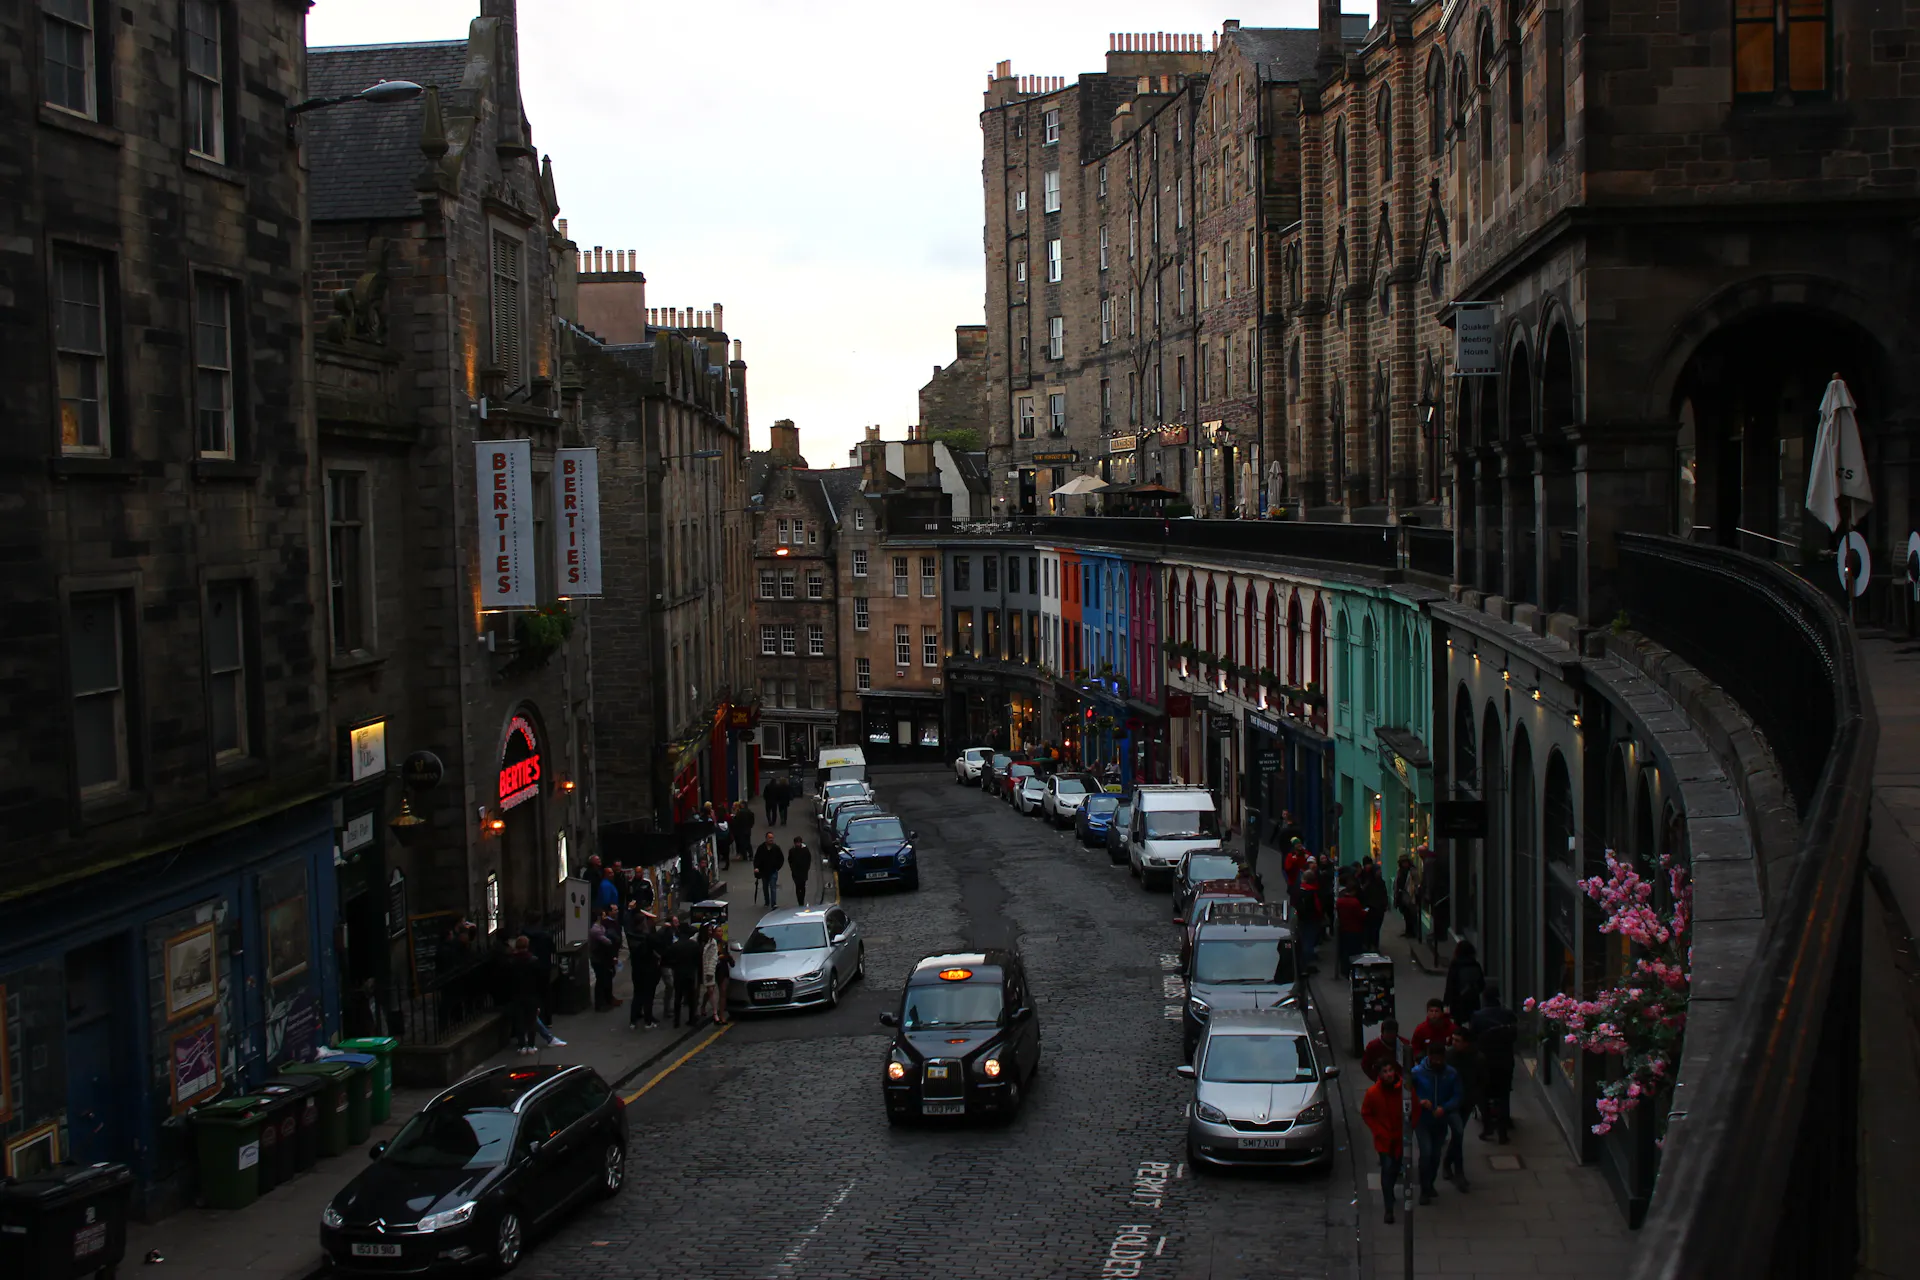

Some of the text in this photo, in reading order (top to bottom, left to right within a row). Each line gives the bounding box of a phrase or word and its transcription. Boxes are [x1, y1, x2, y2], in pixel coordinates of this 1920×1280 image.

[1461, 323, 1490, 331] Quaker
[1461, 336, 1492, 344] Meeting
[1463, 348, 1489, 356] House
[492, 453, 511, 593] BERTIES
[563, 459, 580, 583] BERTIES
[500, 754, 541, 799] BERTIE'S
[1243, 1138, 1280, 1146] SM17 XUV
[1128, 1161, 1171, 1208] PERMIT
